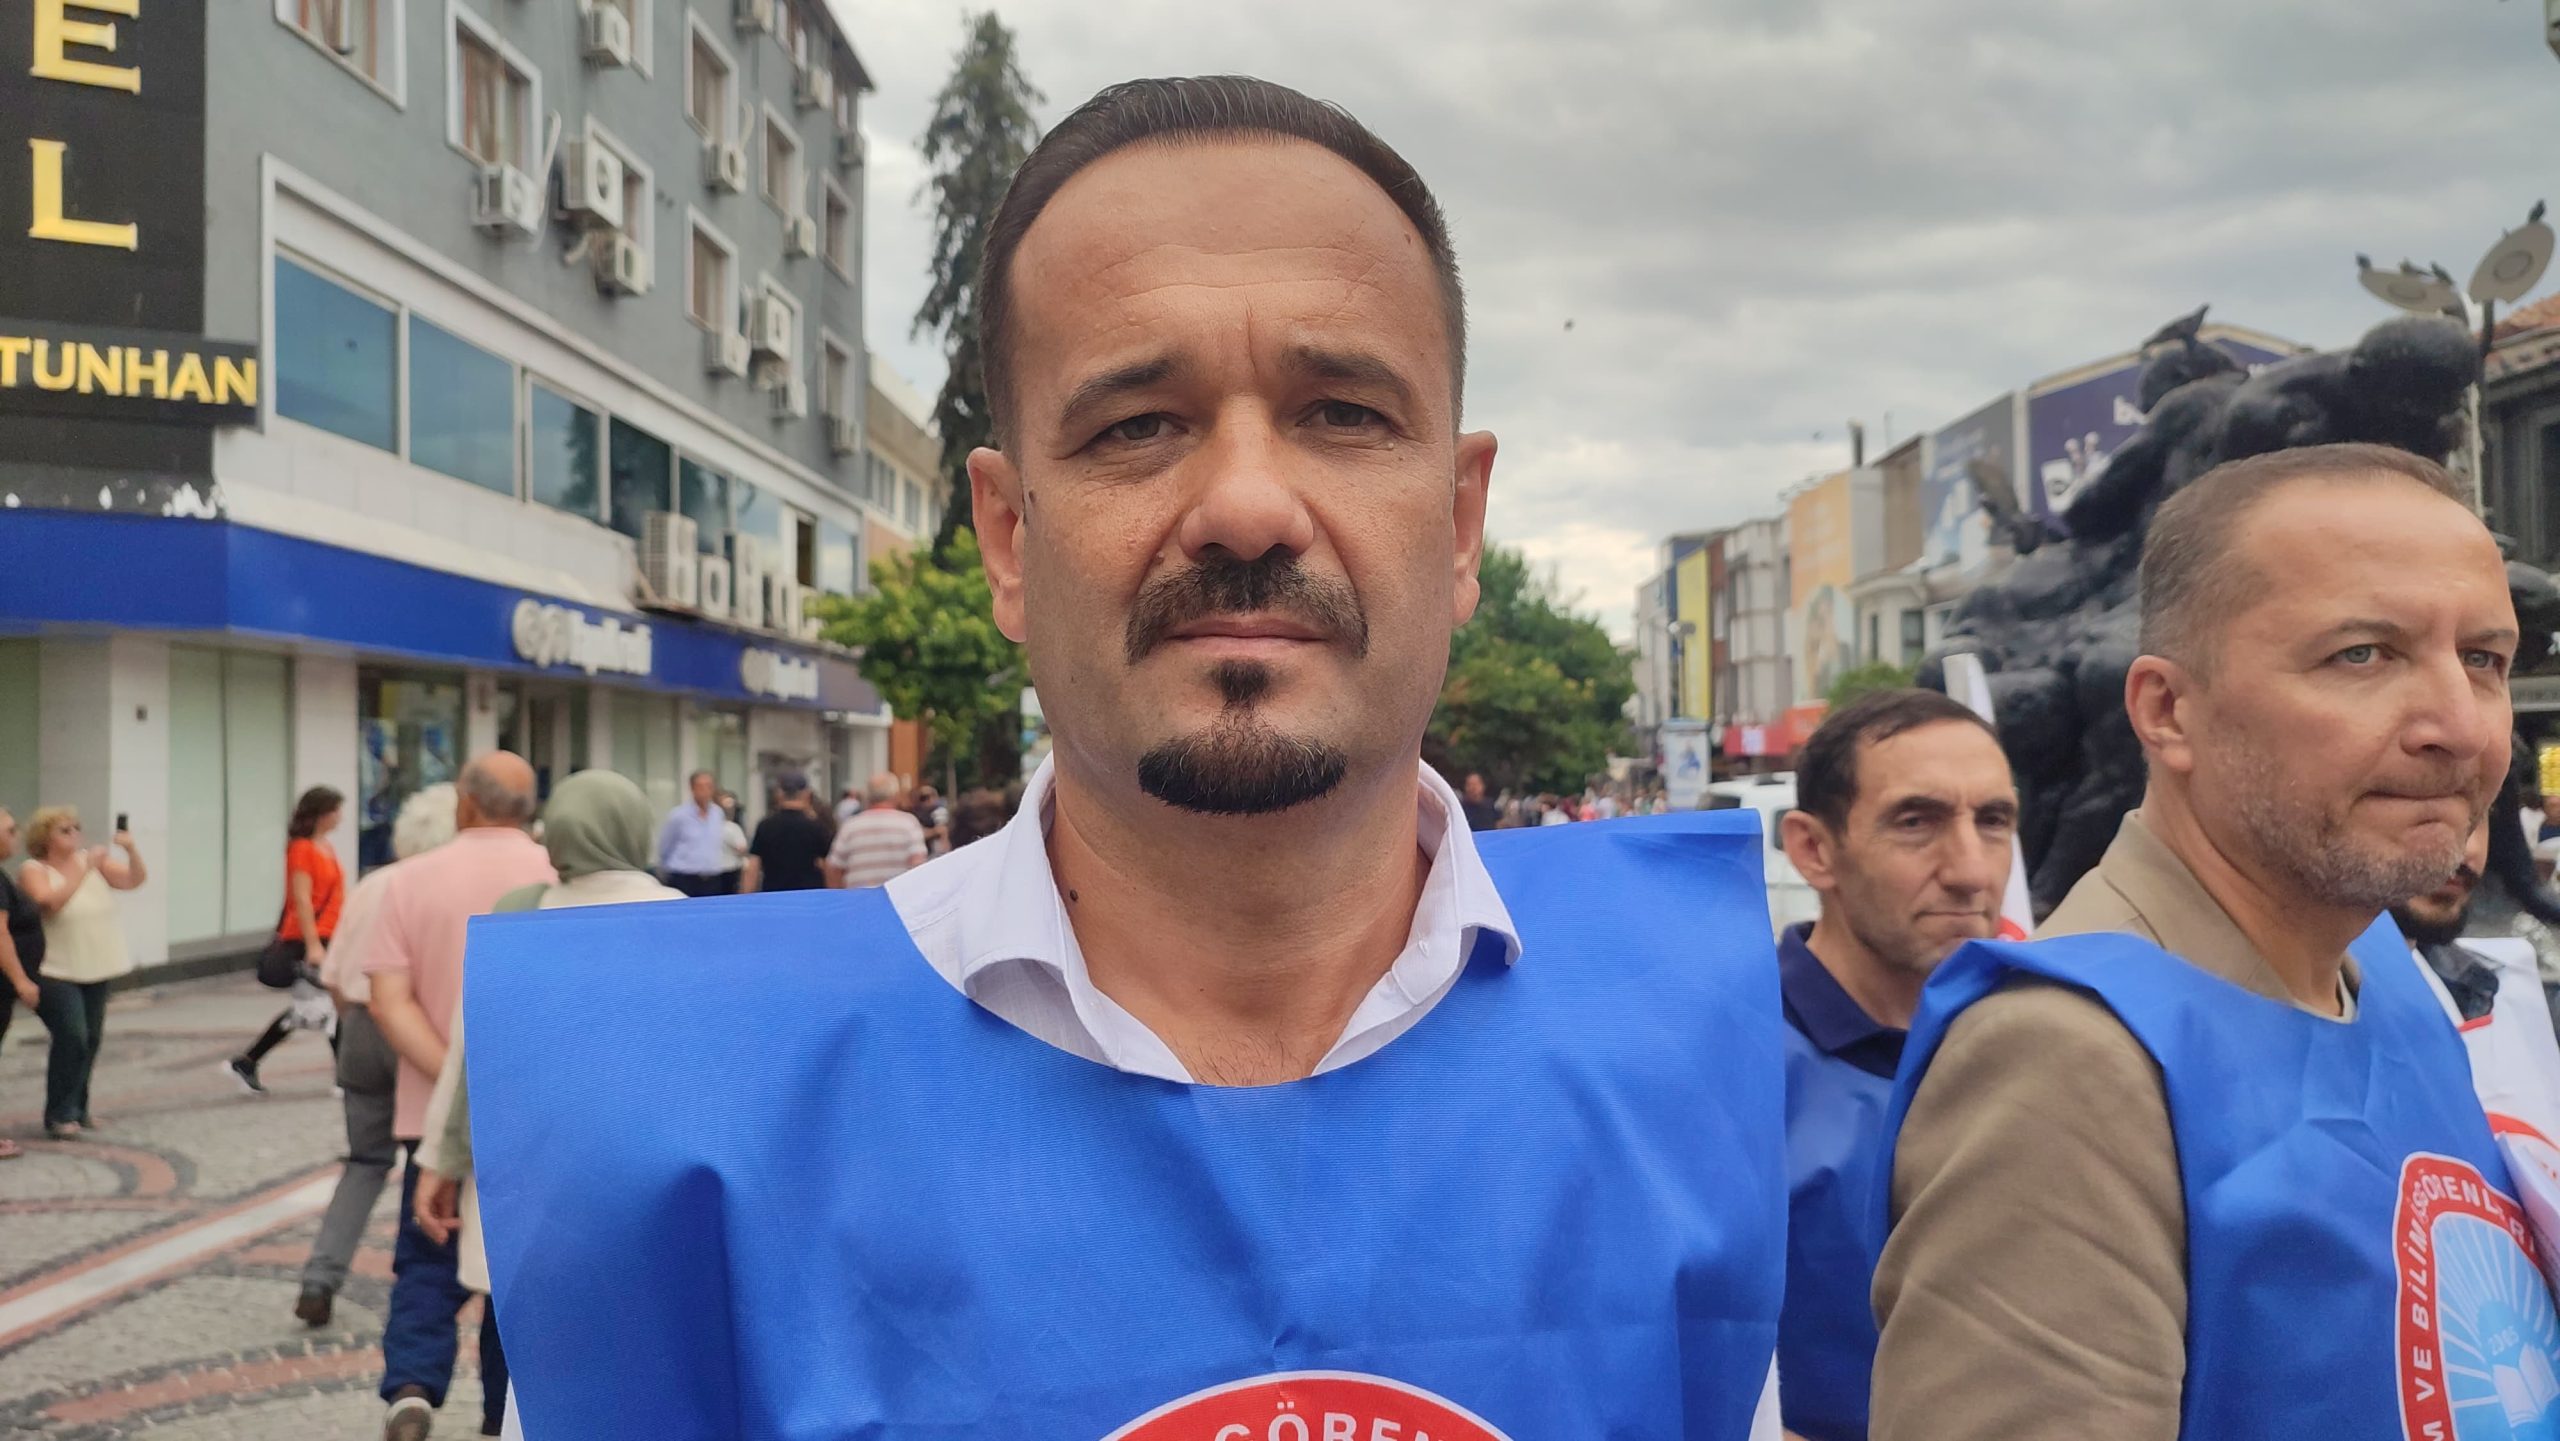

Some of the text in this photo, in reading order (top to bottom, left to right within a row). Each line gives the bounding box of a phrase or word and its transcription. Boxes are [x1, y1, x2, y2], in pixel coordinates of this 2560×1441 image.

[0, 335, 258, 408] TUNHAN
[2402, 1218, 2431, 1331] BİLİM
[2412, 1345, 2436, 1402] VE
